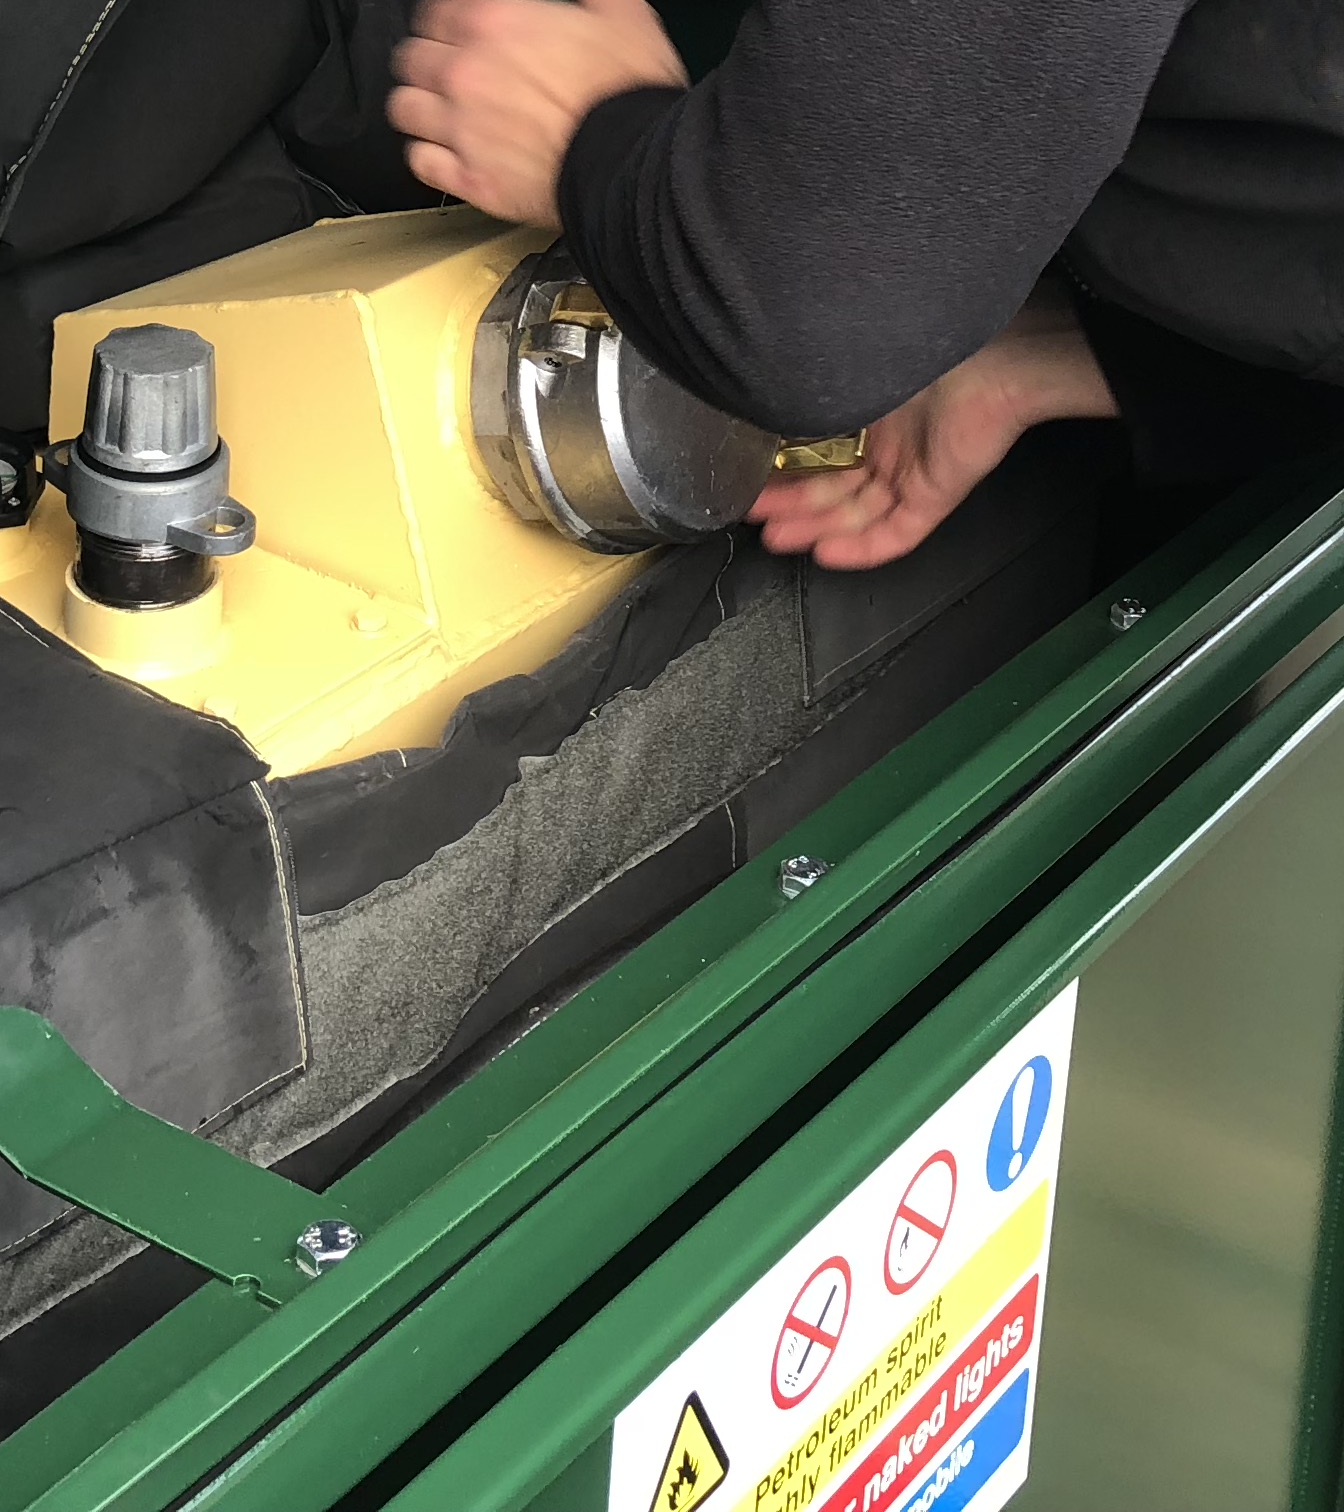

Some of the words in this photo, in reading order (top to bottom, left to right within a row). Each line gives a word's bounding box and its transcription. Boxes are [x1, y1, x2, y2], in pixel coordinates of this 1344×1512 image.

[755, 1368, 878, 1512] Petroleum
[885, 1295, 943, 1373] spirit
[829, 1331, 947, 1472] flammable
[863, 1389, 948, 1512] naked
[953, 1315, 1025, 1411] lights
